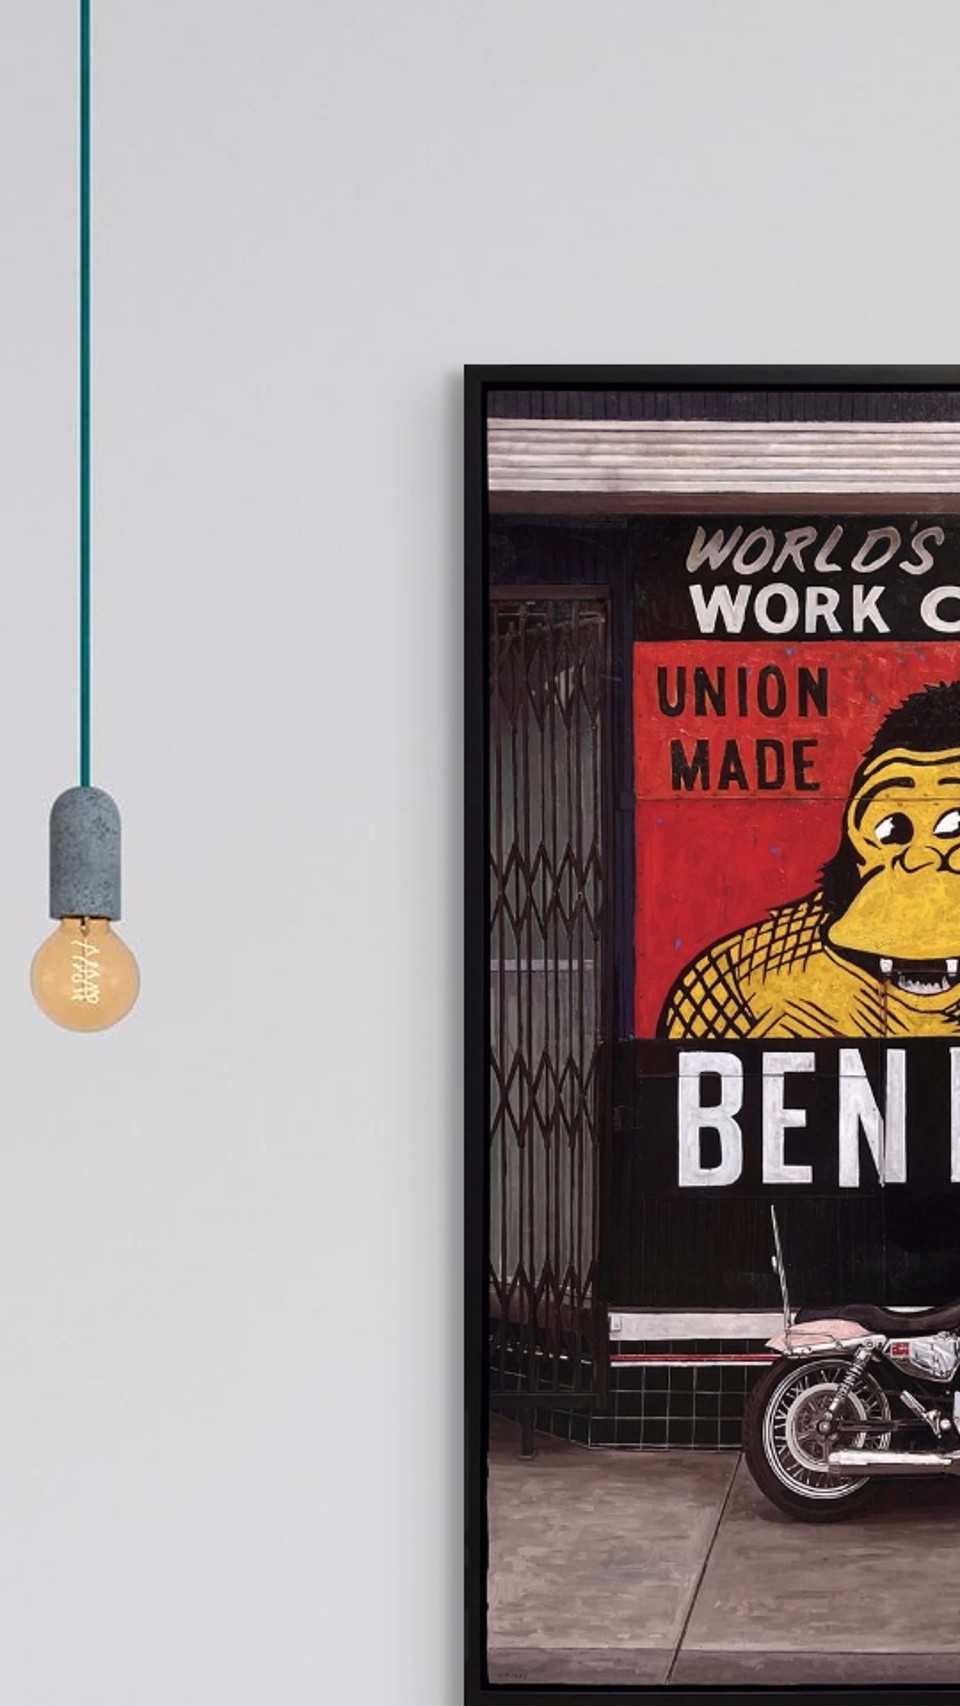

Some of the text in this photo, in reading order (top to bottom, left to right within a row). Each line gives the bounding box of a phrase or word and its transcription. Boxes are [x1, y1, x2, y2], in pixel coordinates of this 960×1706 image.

[685, 521, 945, 576] WORLD'S
[689, 583, 891, 635] WORK
[656, 664, 830, 718] UNION
[669, 738, 822, 793] MADE
[677, 1048, 908, 1188] BEN
